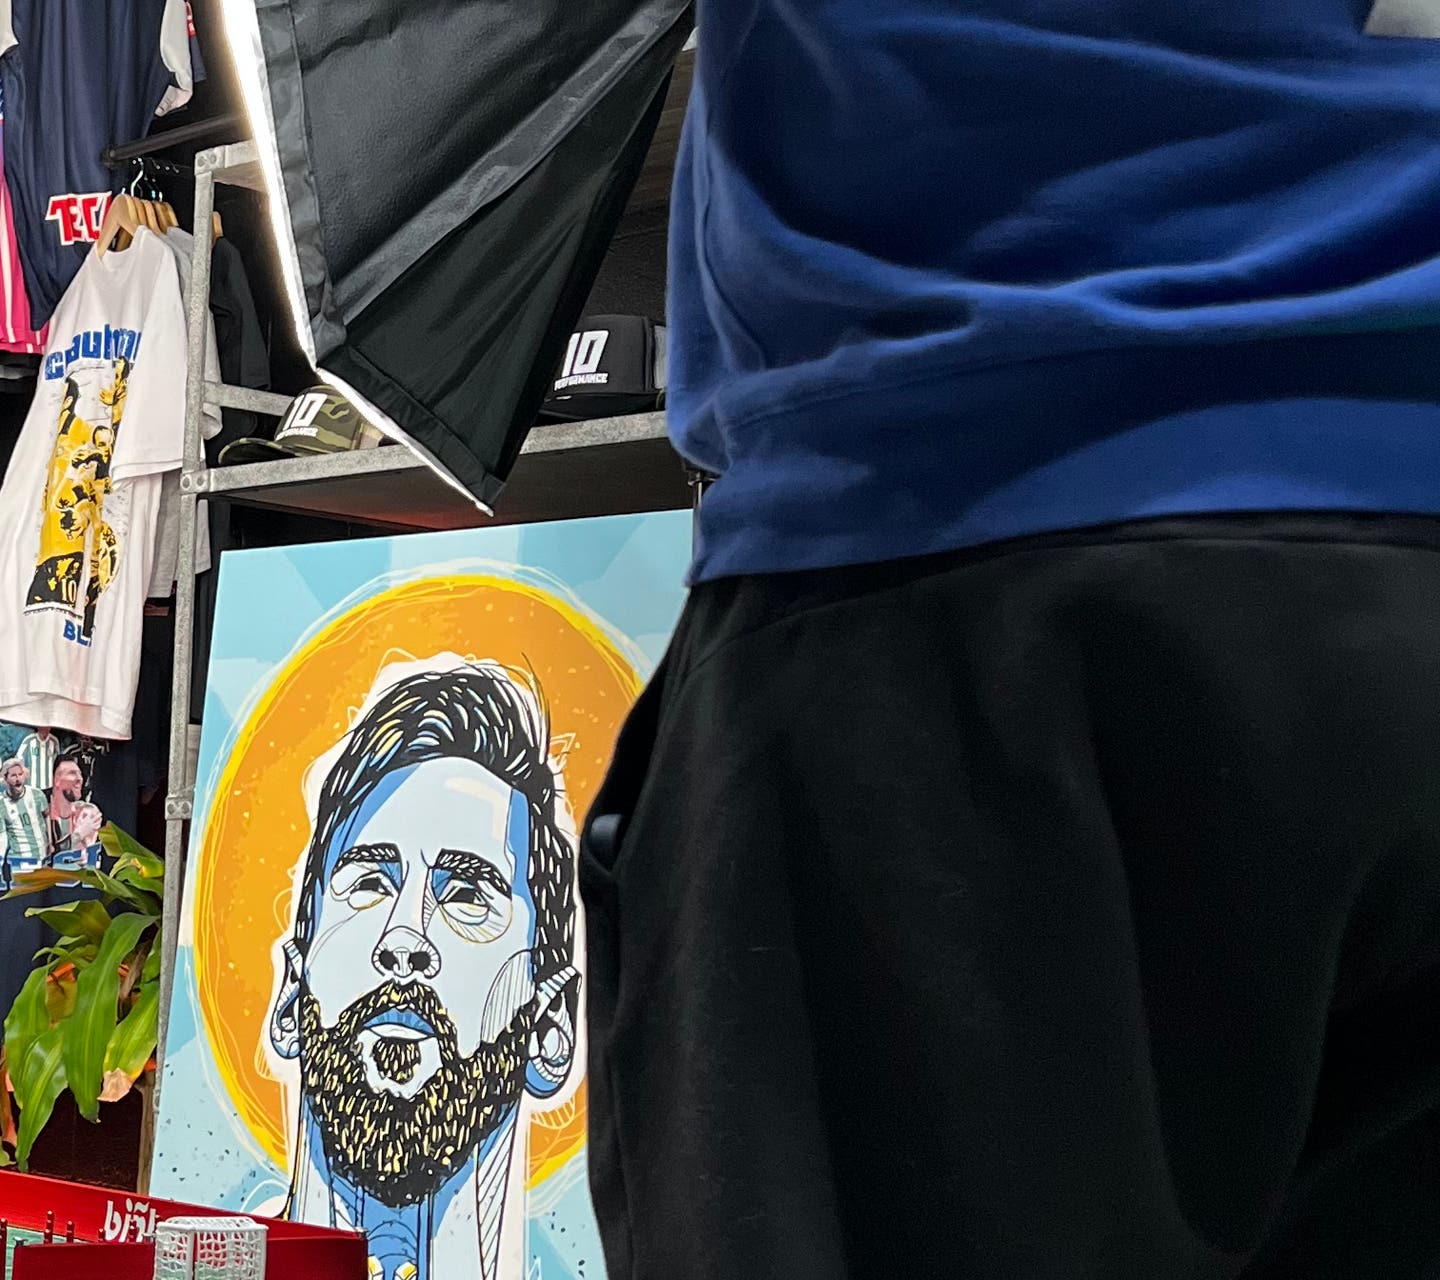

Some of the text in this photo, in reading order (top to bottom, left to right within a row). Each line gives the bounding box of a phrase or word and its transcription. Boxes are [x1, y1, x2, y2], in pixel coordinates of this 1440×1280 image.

[561, 330, 609, 377] 10
[282, 393, 328, 431] 10
[62, 578, 76, 603] 10
[63, 620, 91, 647] BL
